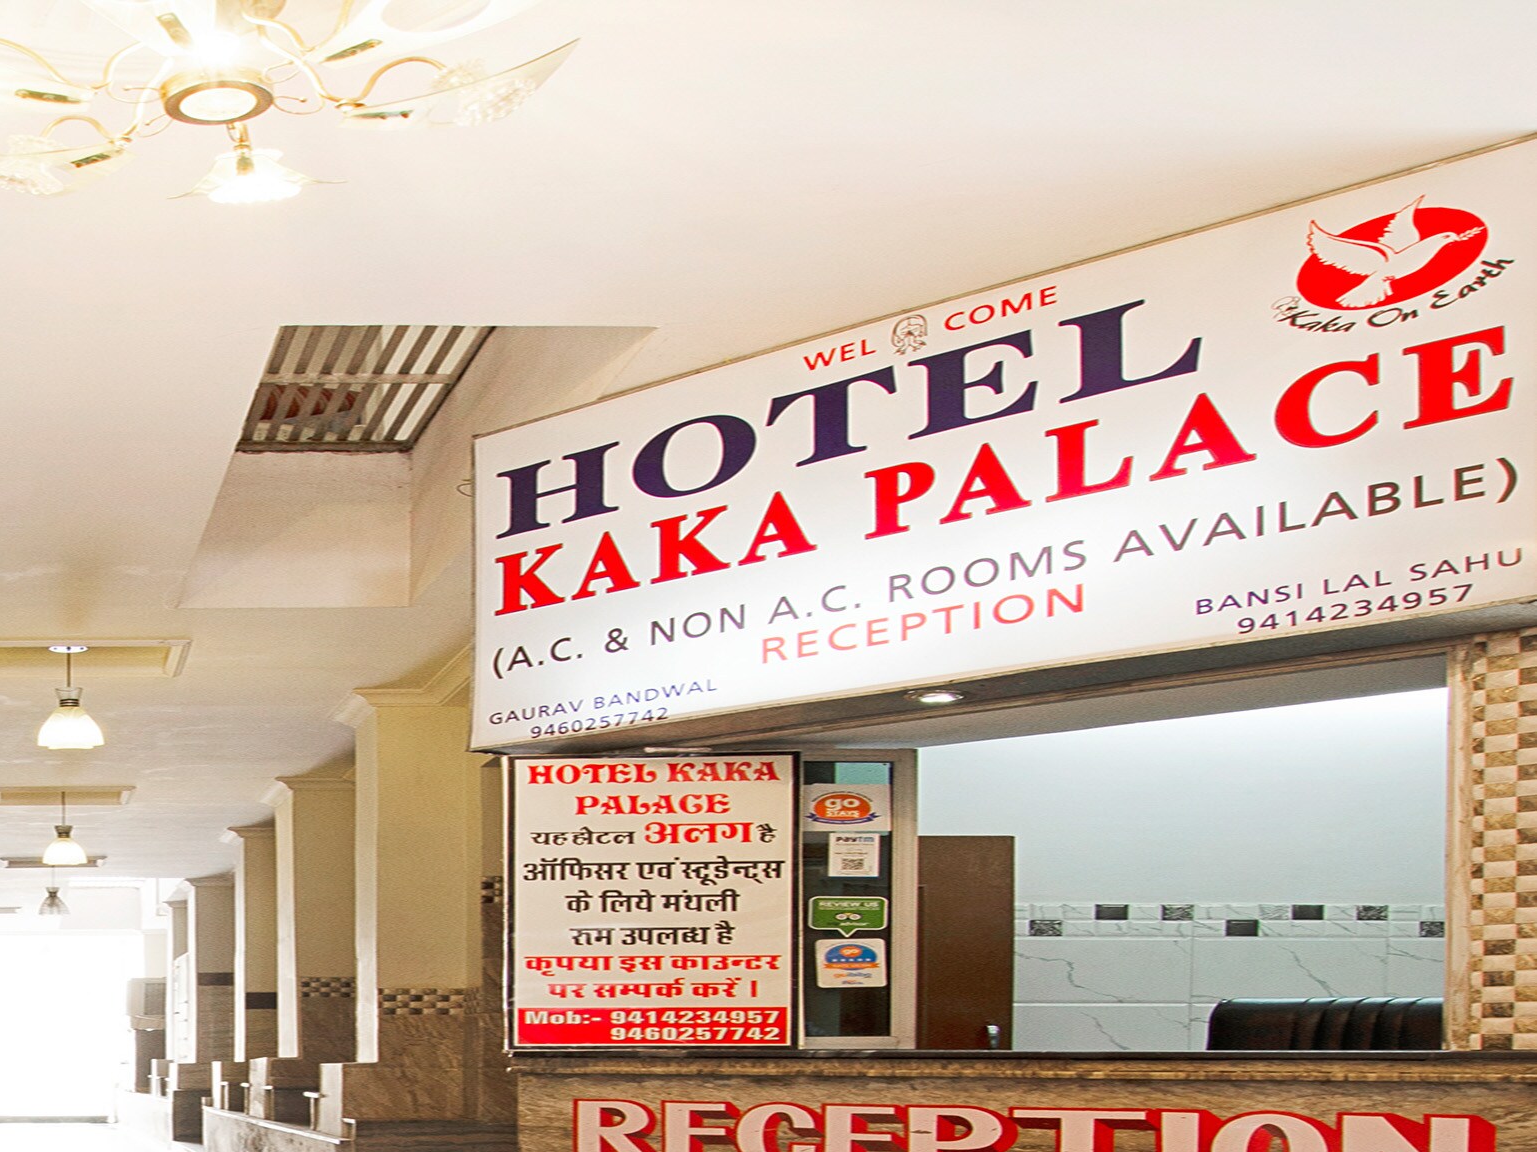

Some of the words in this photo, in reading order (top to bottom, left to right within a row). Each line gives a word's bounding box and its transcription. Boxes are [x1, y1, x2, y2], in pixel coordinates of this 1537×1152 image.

[1277, 310, 1357, 333] Kaka
[1367, 307, 1419, 328] On
[1430, 255, 1516, 310] Earth
[803, 338, 877, 371] WEL
[944, 286, 1058, 332] COME
[495, 299, 1203, 539] HOTEL
[494, 491, 818, 617] KAKA
[864, 325, 1515, 540] PALACE
[491, 635, 583, 679] (A.C.
[604, 627, 630, 654] &
[649, 604, 747, 645] NON
[767, 585, 861, 624] A.C.
[887, 539, 1087, 603] ROOMS
[1113, 457, 1519, 563] AVAILABLE)
[1195, 582, 1304, 615] BANSI
[1323, 569, 1392, 595] LAL
[1409, 547, 1523, 581] SAHU
[1238, 583, 1473, 634] 9414234957
[761, 583, 1085, 664] RECEPTION
[489, 699, 583, 725] GAURAV
[593, 679, 718, 710] BANDWAL
[529, 706, 670, 739] 9460257742
[528, 763, 657, 784] HOTEL
[666, 761, 780, 782] KAKA
[575, 793, 731, 815] PALACE
[824, 798, 861, 811] go
[644, 821, 754, 844] अलग
[756, 823, 777, 843] है
[523, 857, 630, 881] ऑफिसर
[636, 857, 680, 880] एवं
[565, 890, 592, 913] के
[599, 889, 655, 912] लिये
[661, 889, 740, 912] मंथली
[620, 926, 711, 945] उपलब्ध
[715, 920, 736, 945] है
[524, 955, 614, 976] कृपया
[619, 955, 664, 973] इस
[670, 954, 782, 971] काउन्टर
[548, 983, 586, 998] पर
[610, 1010, 780, 1025] 9414234957
[610, 1026, 780, 1041] 9460257742
